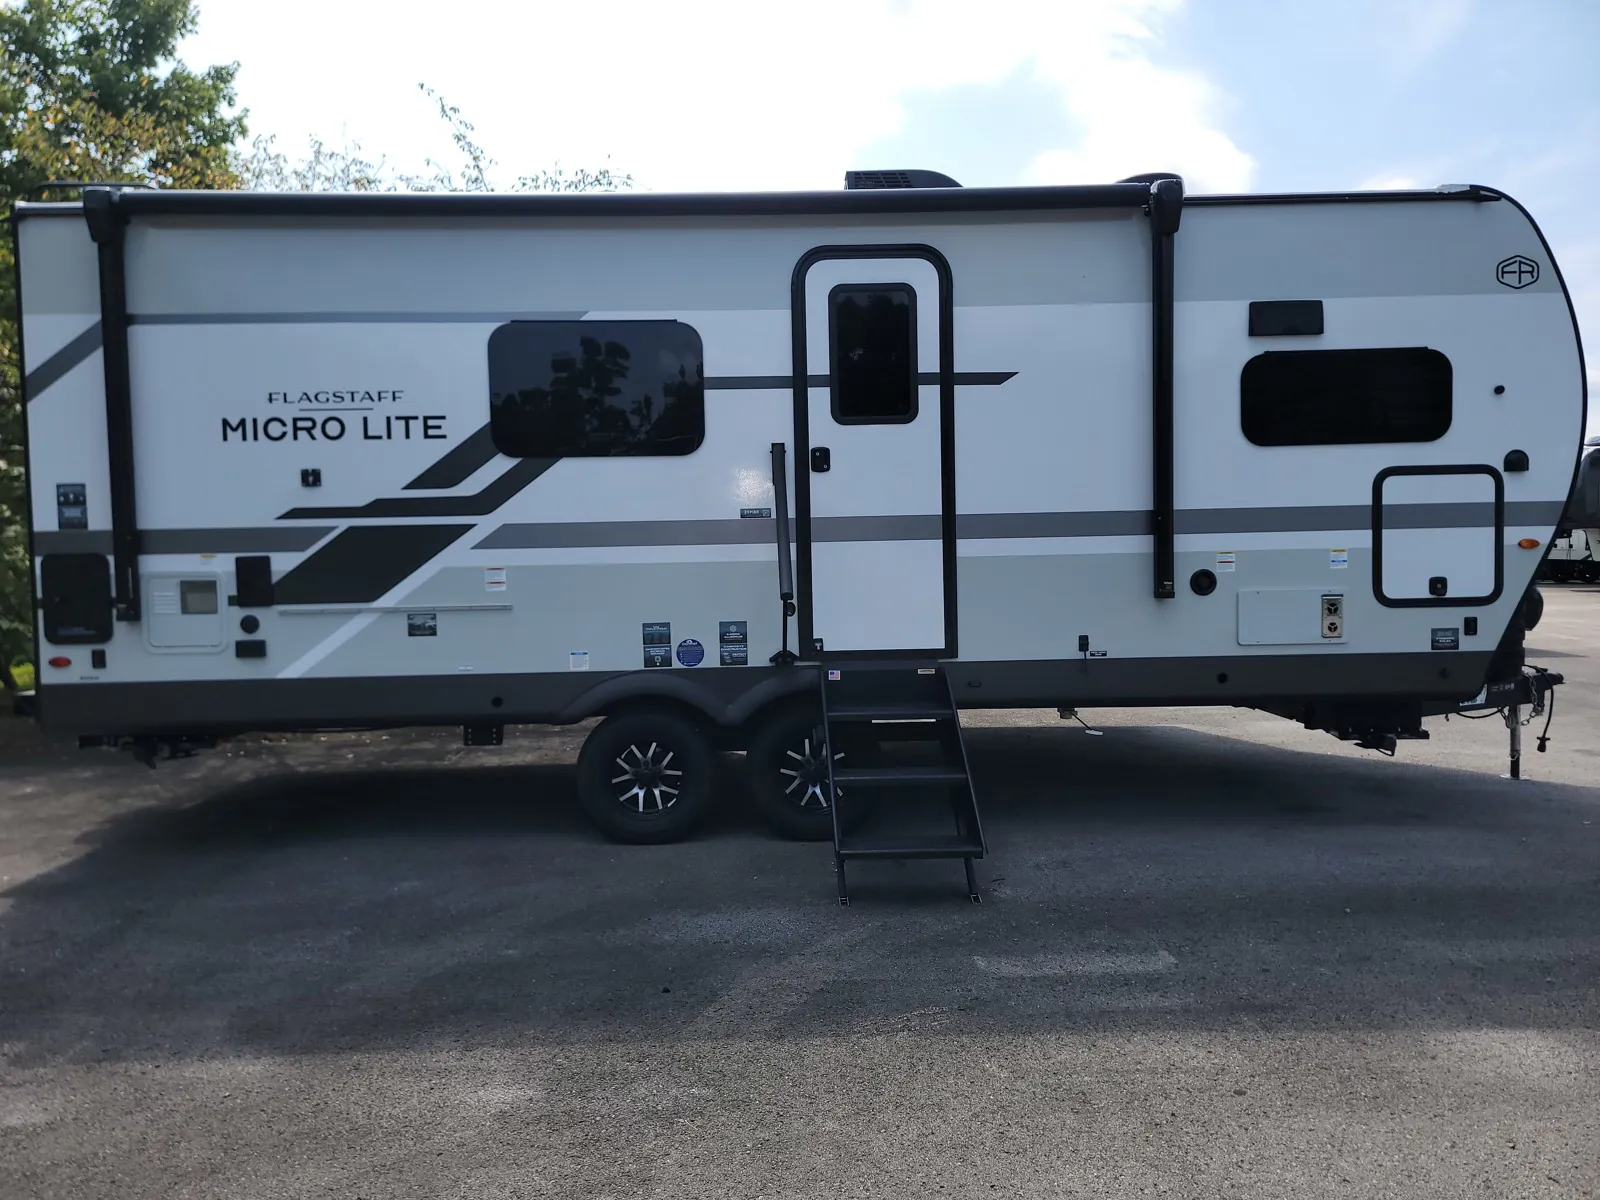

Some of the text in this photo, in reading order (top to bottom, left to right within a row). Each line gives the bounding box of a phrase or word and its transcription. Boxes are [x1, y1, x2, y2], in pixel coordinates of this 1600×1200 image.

[1500, 259, 1535, 285] FR
[267, 390, 404, 404] FLAGSTAFF
[221, 415, 447, 442] MICRO LITE
